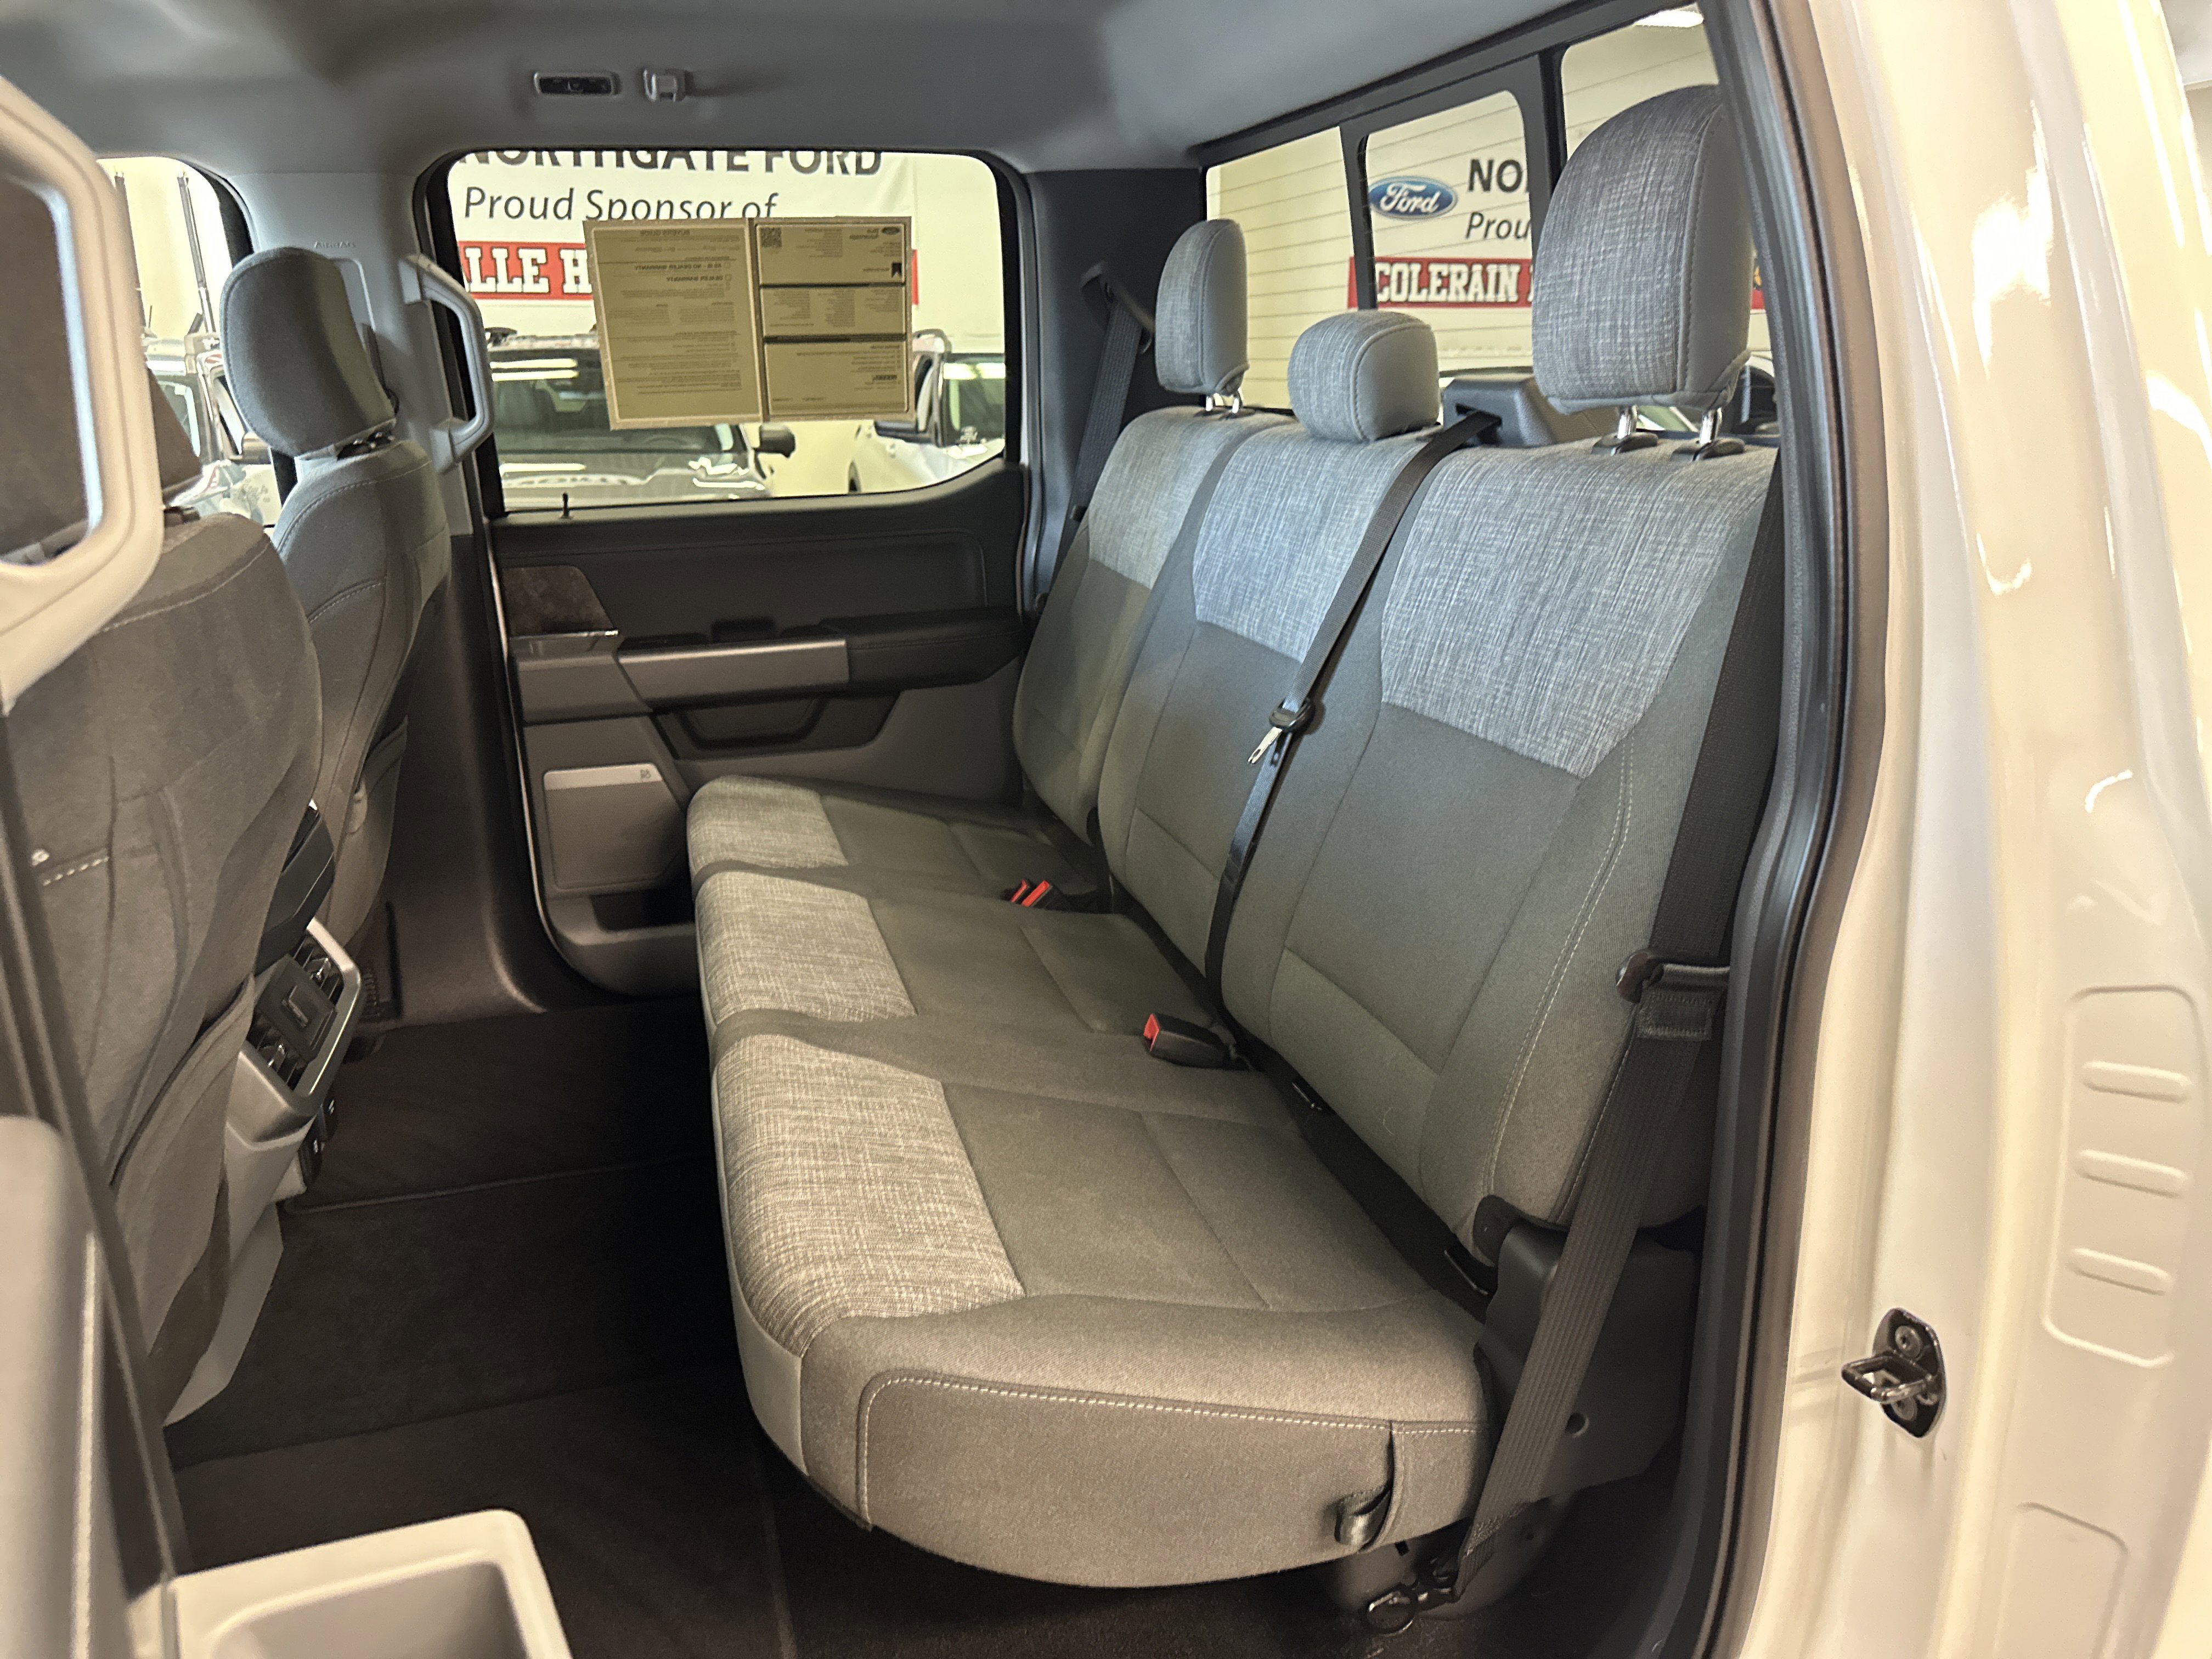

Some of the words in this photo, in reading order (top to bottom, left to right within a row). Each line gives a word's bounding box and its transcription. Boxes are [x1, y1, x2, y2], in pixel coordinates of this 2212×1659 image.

[1468, 159, 1530, 193] NO
[465, 187, 574, 219] Proud
[585, 189, 733, 220] Sponsor
[742, 192, 779, 218] of
[1379, 183, 1441, 213] Ford
[461, 247, 550, 293] LLE
[1375, 262, 1521, 303] COLERAIN
